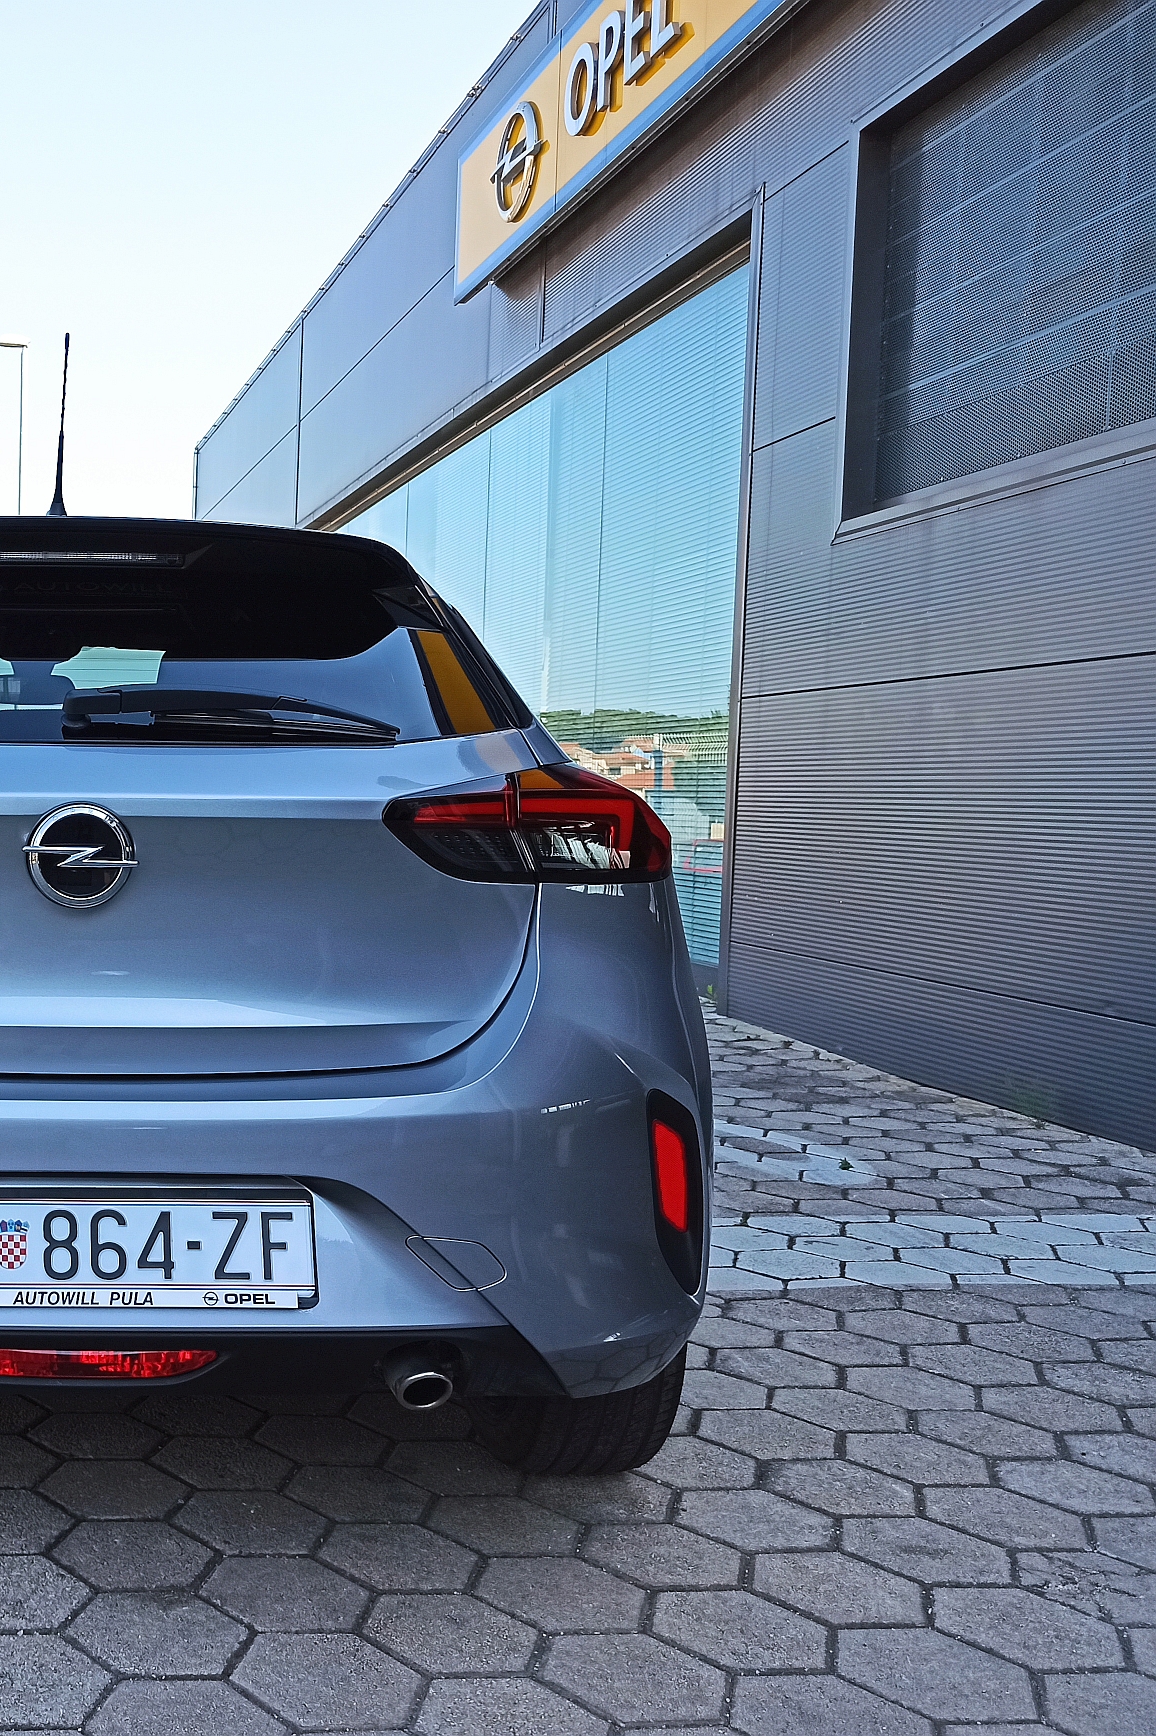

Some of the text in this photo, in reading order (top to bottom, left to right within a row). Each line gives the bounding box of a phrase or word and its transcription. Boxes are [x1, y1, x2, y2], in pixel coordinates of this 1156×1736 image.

[564, 0, 681, 136] OPEL
[12, 1291, 154, 1306] AUTOWILL PULA
[224, 1292, 276, 1305] OPEL
